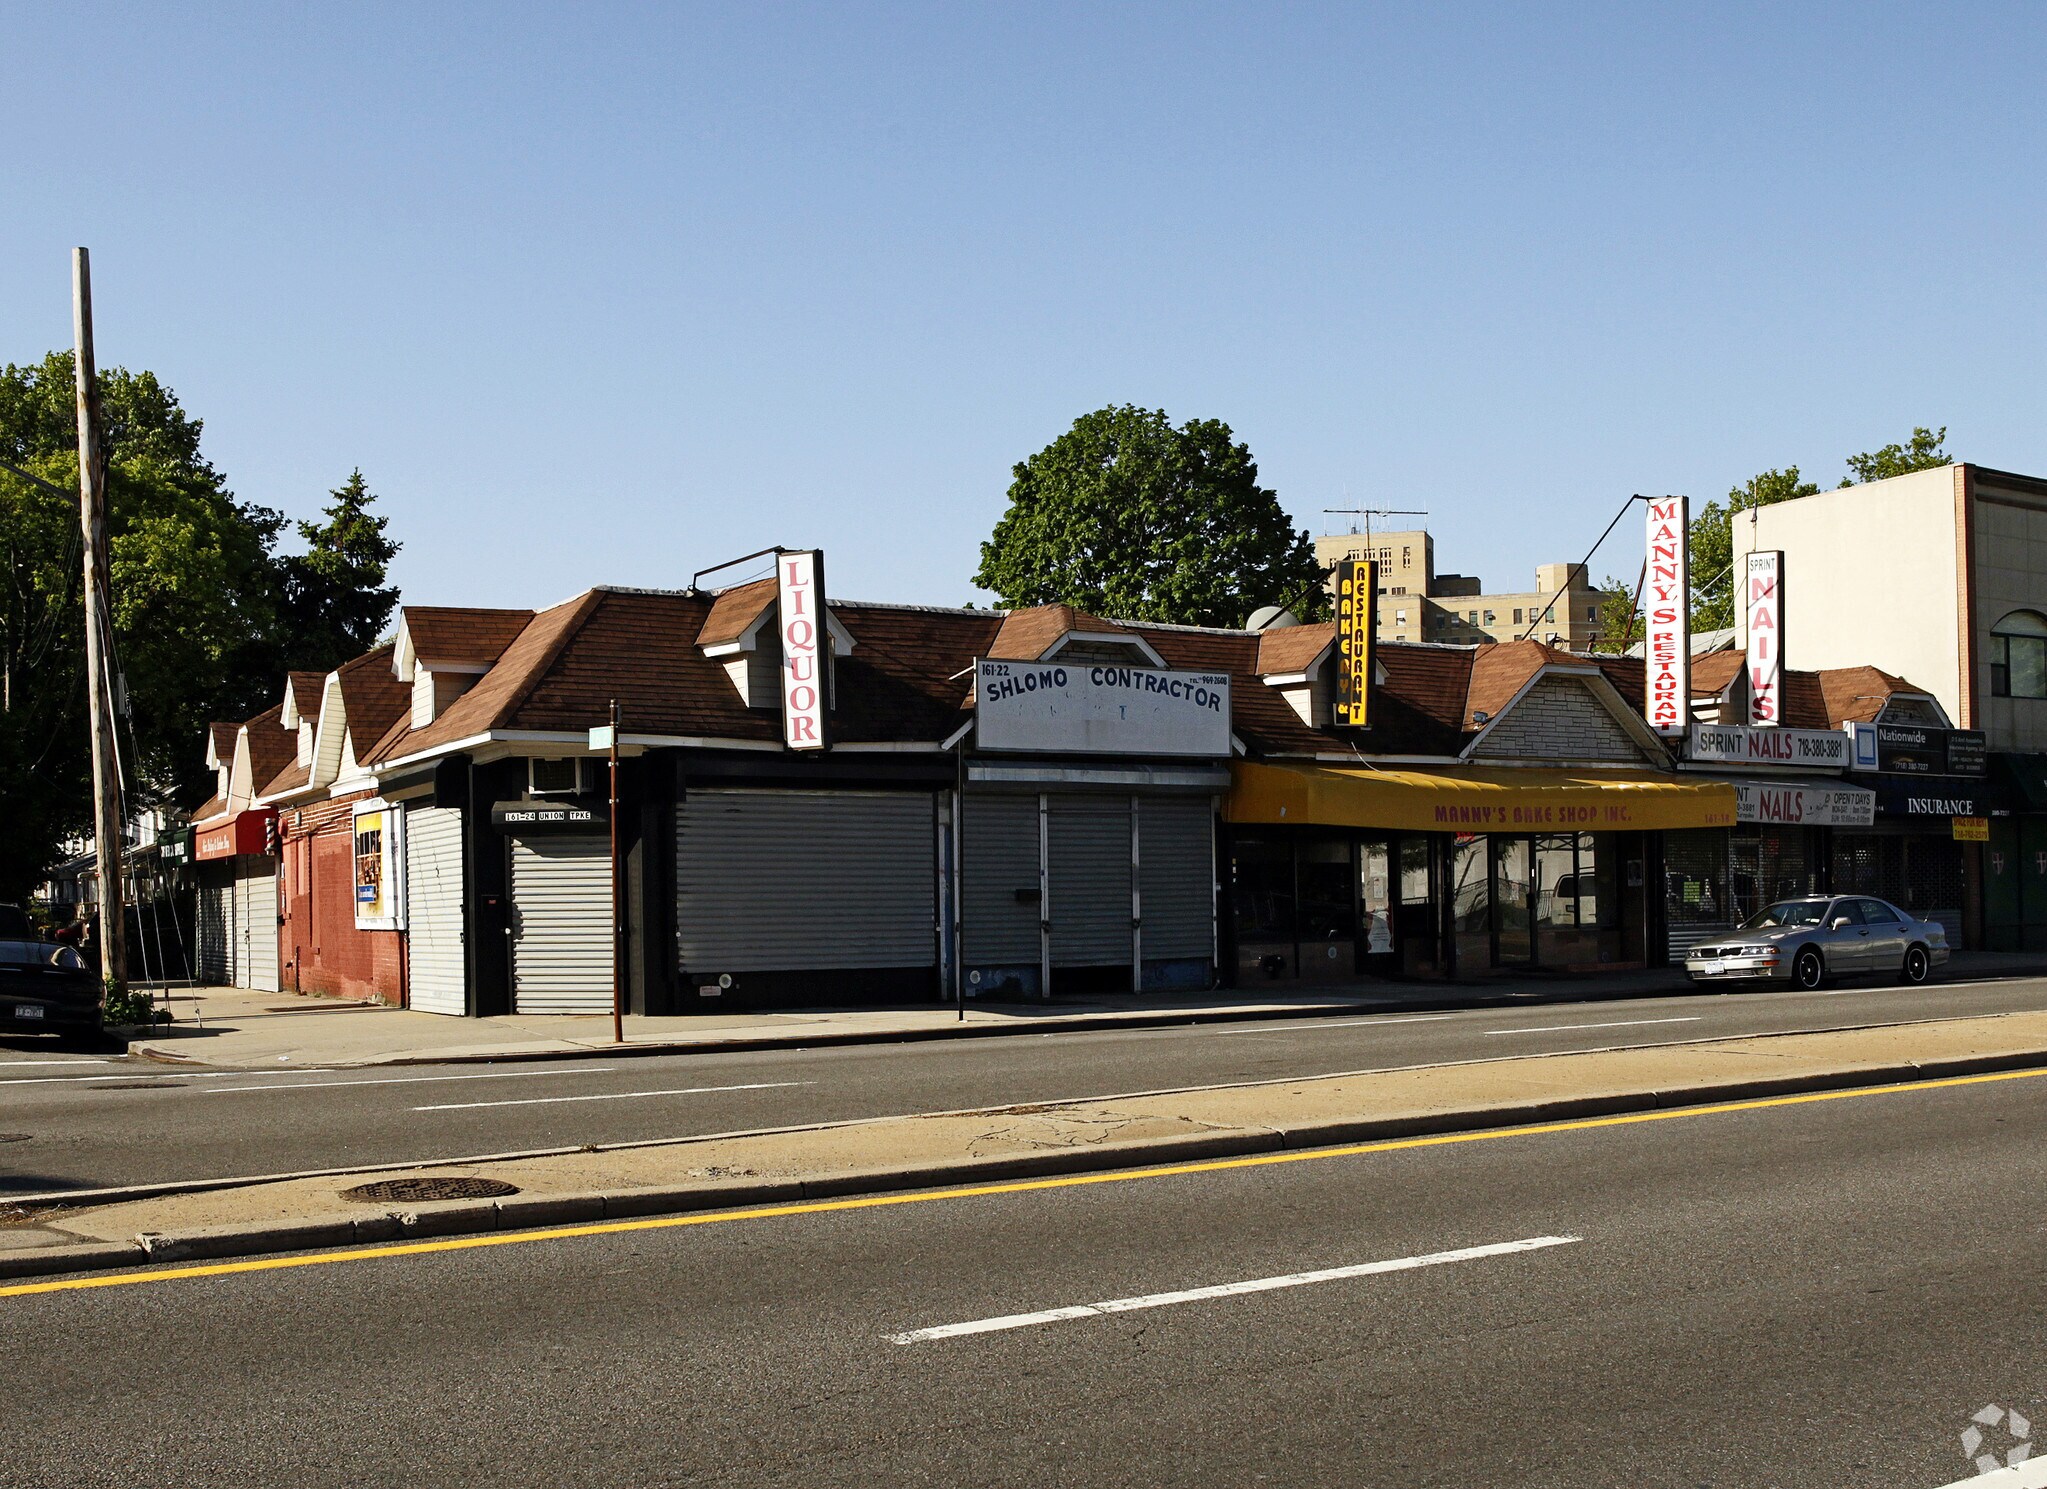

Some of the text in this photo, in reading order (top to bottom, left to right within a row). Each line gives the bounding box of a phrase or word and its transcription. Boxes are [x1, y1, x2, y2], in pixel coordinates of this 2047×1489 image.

[1652, 502, 1678, 625] MANNY'S
[1749, 557, 1775, 571] SPRINT
[786, 561, 818, 741] LIQUOR
[1339, 579, 1352, 694] BAKERY
[1352, 566, 1366, 719] RESTAURANT
[1751, 576, 1775, 720] NAILS
[986, 667, 1221, 712] SHLOMO CONTRACTOR
[1653, 632, 1677, 730] RESTAURANT
[1337, 703, 1349, 715] &
[1700, 731, 1843, 759] SPRINT NAILS 718-380-3881
[1879, 728, 1926, 744] Nationwide
[1435, 805, 1632, 823] MANNY'S BAKE SHOP INC.
[1759, 789, 1803, 823] NAILS
[1834, 793, 1850, 804] OPEN
[1850, 793, 1855, 804] 7
[1855, 793, 1871, 805] DAYS
[1908, 798, 1974, 815] INSURANCE
[507, 811, 590, 821] 161-24 UNION TPKE
